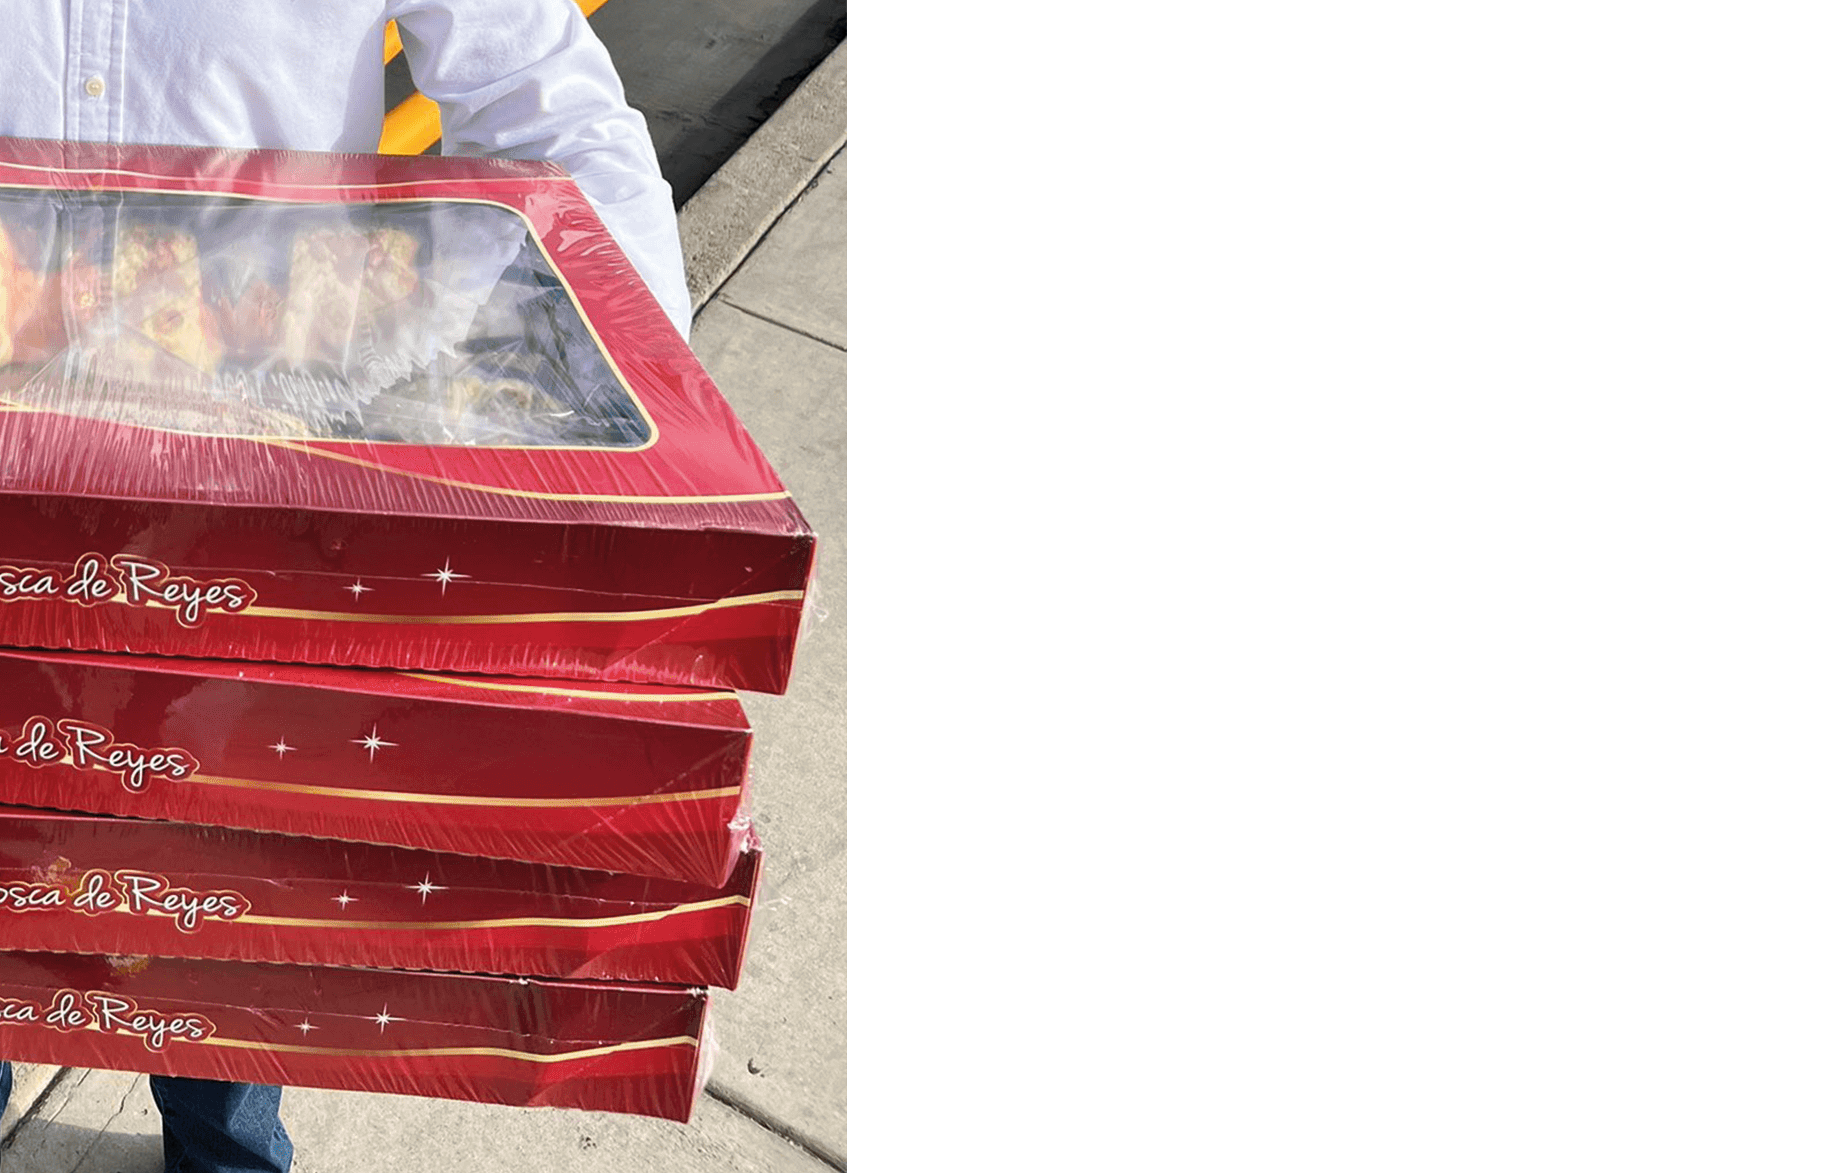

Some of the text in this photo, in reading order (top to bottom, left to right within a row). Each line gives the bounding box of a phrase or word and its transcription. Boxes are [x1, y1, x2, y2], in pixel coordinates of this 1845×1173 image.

[68, 560, 115, 599] de
[120, 562, 245, 622] Reyes
[16, 723, 58, 759] de
[67, 727, 190, 788] Reyes
[73, 873, 117, 912] de
[123, 877, 242, 927] Reyes
[46, 994, 88, 1027] de
[93, 997, 206, 1047] Reyes
